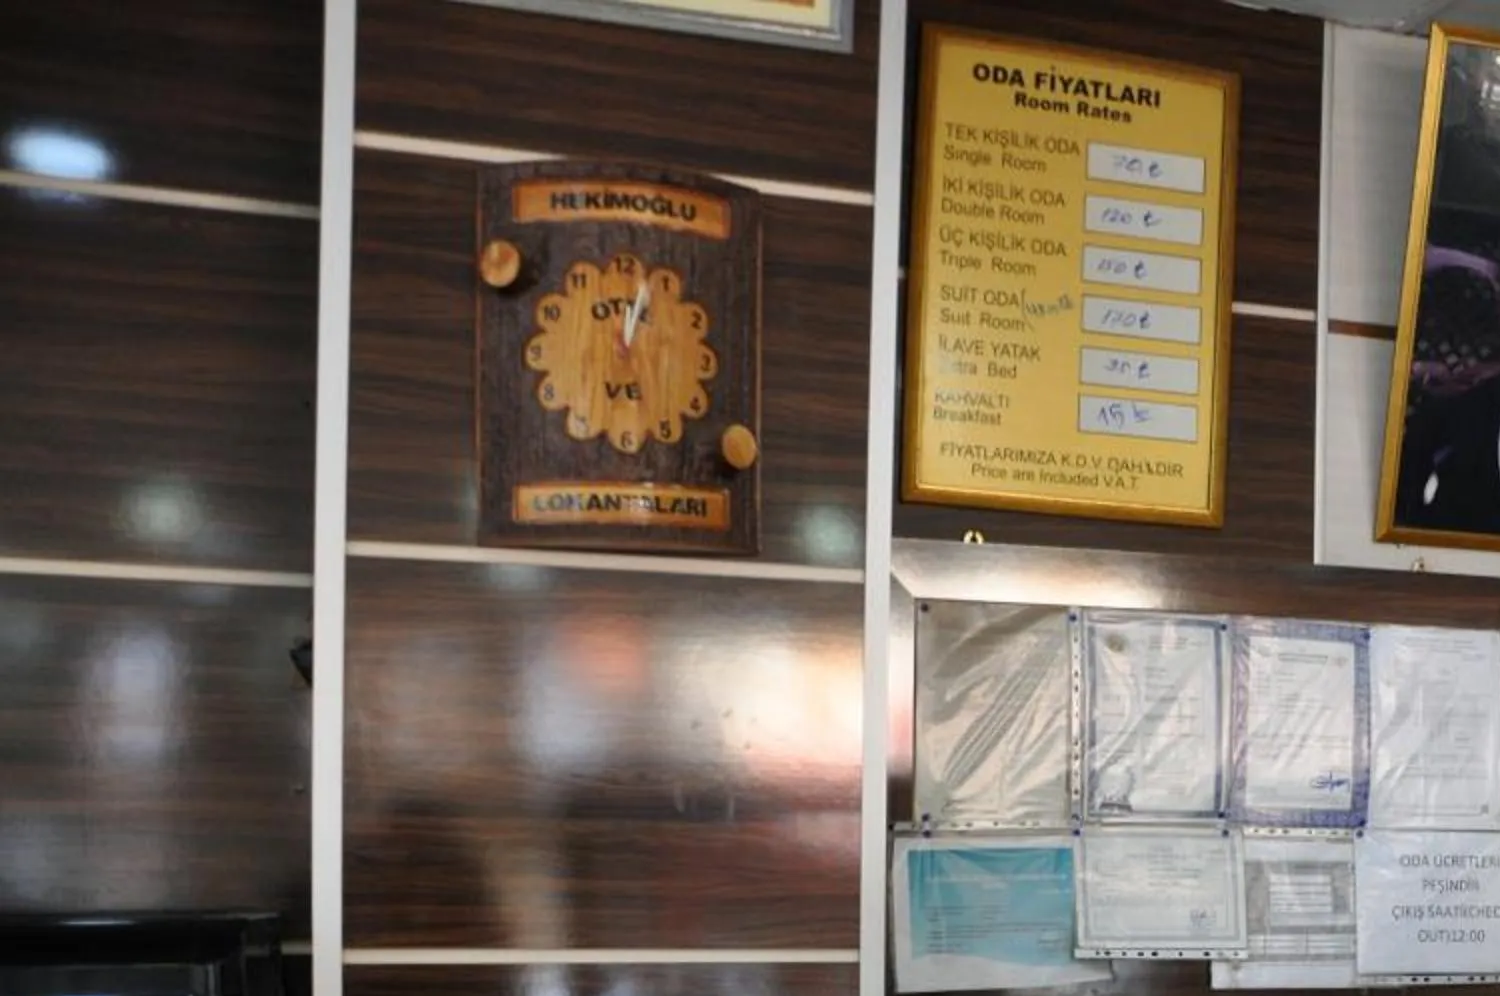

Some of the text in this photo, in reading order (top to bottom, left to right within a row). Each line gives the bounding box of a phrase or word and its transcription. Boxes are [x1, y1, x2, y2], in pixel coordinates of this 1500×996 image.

[972, 63, 1161, 108] ODA FİYATLARI
[1014, 93, 1132, 124] Room Rates
[945, 122, 977, 141] TEK
[1044, 136, 1080, 155] ODA
[944, 144, 1047, 172] Single Room
[1029, 189, 1066, 207] ODA
[941, 196, 1045, 224] Double Room
[1031, 238, 1067, 257] ODA
[614, 255, 636, 276] 12
[940, 249, 1036, 277] Triple Room
[572, 274, 586, 289] 11
[662, 276, 670, 292] 1
[983, 289, 1020, 308] ODA
[544, 305, 561, 322] 10
[691, 311, 703, 330] 2
[940, 307, 1025, 332] Suit Room
[530, 346, 541, 361] 9
[990, 341, 1041, 362] YATAK
[701, 354, 711, 372] 3
[988, 361, 1017, 379] Bed
[544, 383, 555, 399] 8
[605, 381, 642, 400] VE
[935, 389, 1010, 409] KAHVALTI
[690, 397, 701, 410] 4
[933, 405, 1001, 426] Breakfast
[660, 420, 672, 439] 5
[620, 431, 635, 449] 6
[971, 462, 1008, 480] Price
[1013, 469, 1034, 482] are
[1401, 855, 1430, 868] ODA
[1392, 904, 1425, 921] ÇIKIŞ
